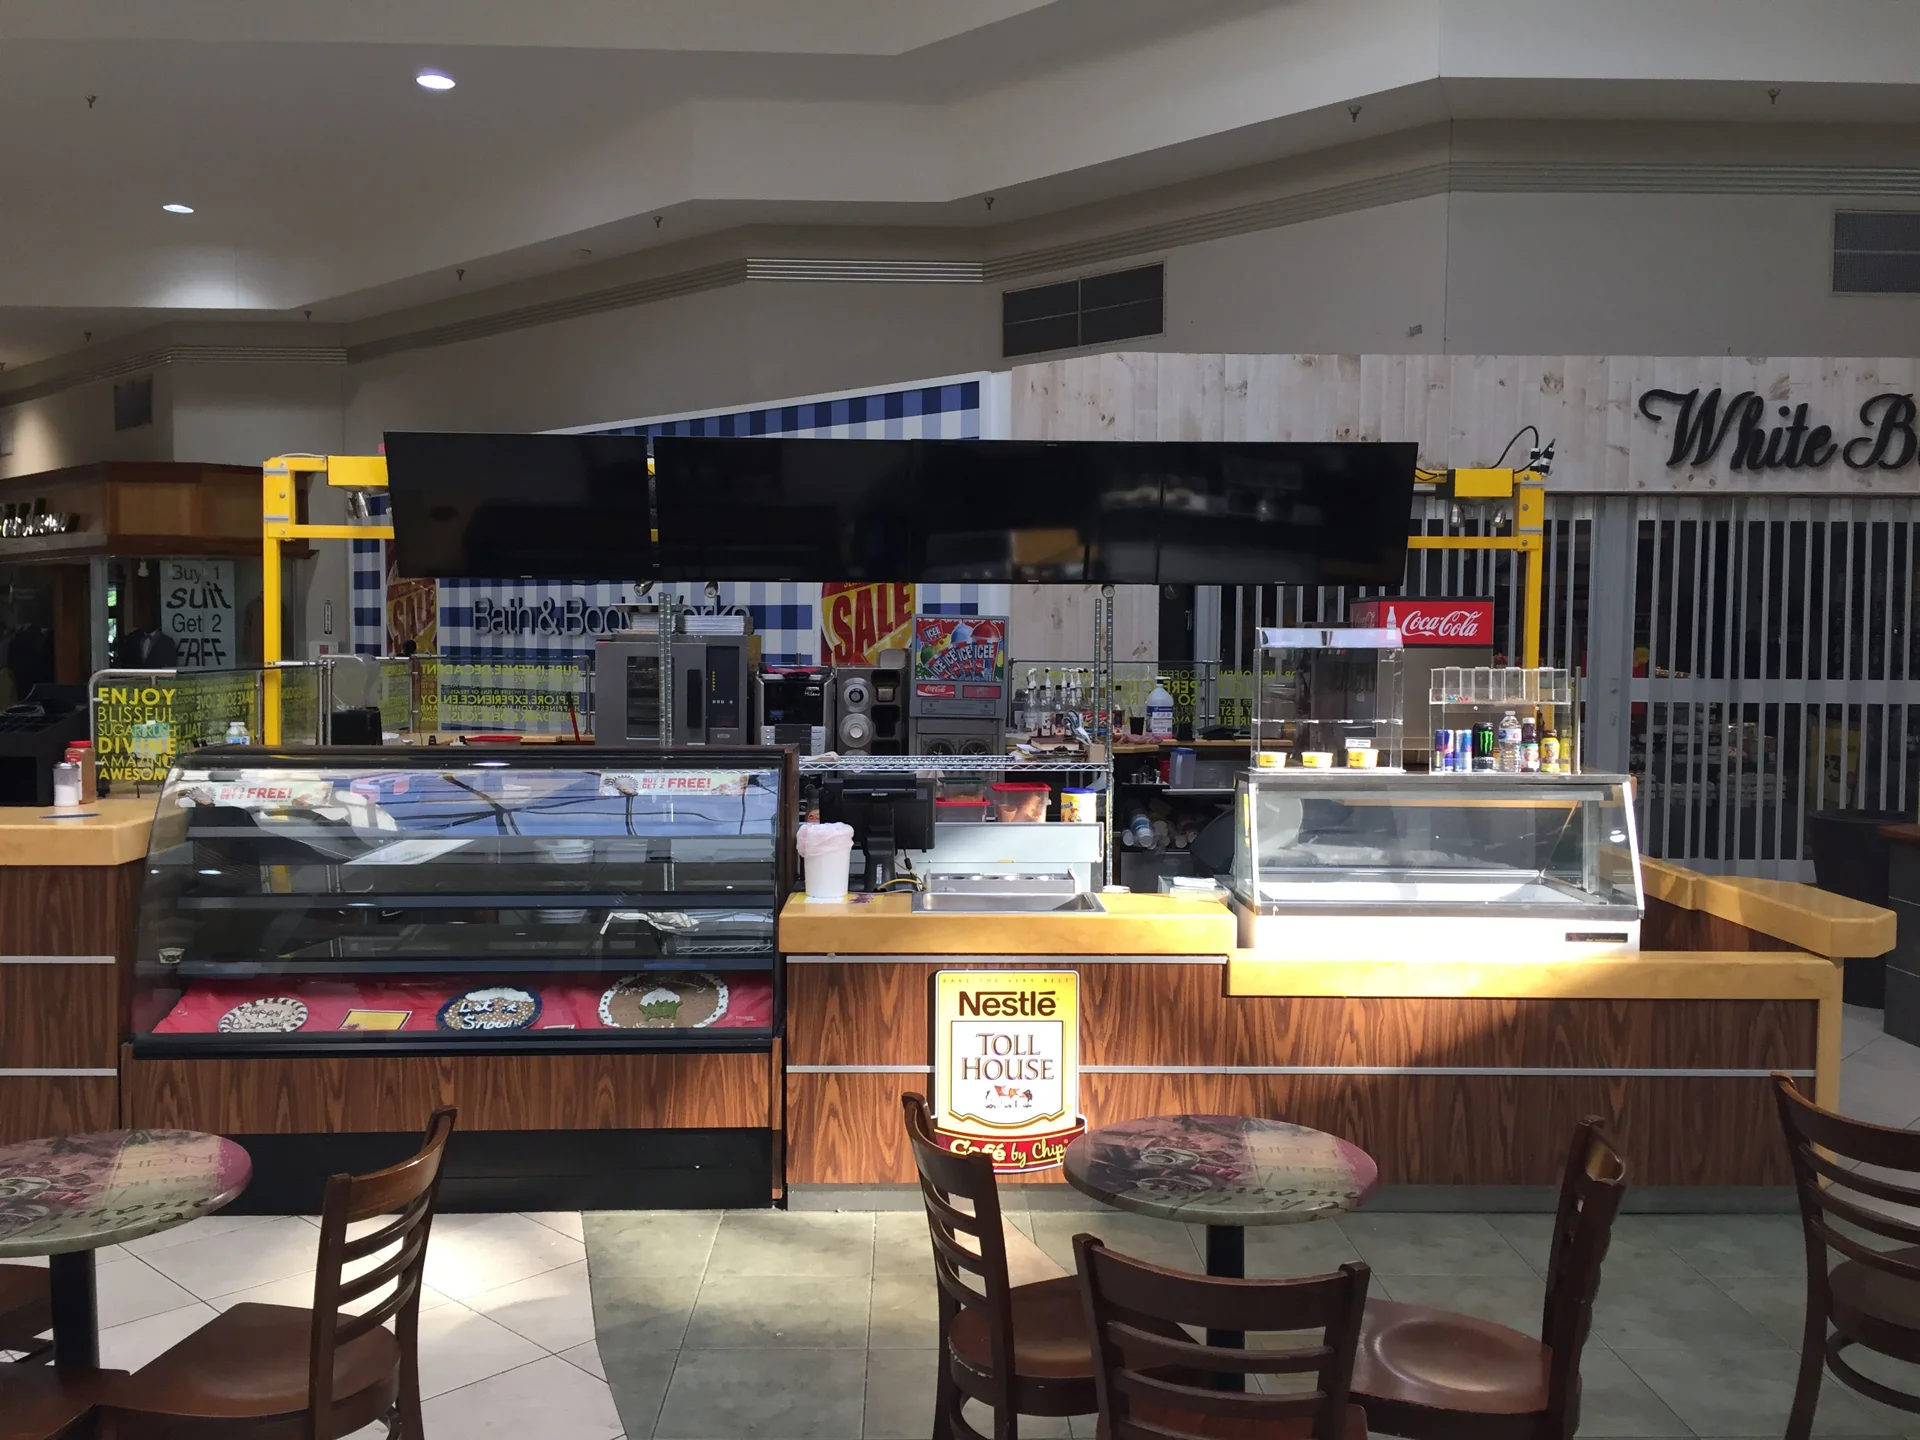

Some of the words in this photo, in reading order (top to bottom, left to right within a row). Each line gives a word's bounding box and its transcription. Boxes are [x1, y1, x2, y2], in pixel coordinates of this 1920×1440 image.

[1638, 388, 1838, 471] White
[1843, 392, 1920, 471] B
[213, 565, 220, 580] 1
[166, 581, 232, 609] suit
[171, 612, 203, 633] Get
[211, 613, 222, 633] 2
[473, 597, 536, 635] Bath
[832, 583, 913, 666] SALE
[1401, 610, 1484, 637] Coca-Cola
[925, 626, 941, 639] ICEE
[943, 648, 958, 666] ICE
[957, 645, 973, 661] ICE
[974, 644, 994, 659] ICEE
[931, 660, 946, 675] ICE
[98, 688, 176, 705] ENJOY
[98, 707, 176, 722] BLISSFUL
[98, 723, 141, 737] SUGAR
[98, 737, 177, 755] DIVINE
[100, 755, 176, 769] AMAZING
[99, 768, 168, 781] AWESOM
[667, 777, 711, 789] FREE!
[246, 787, 293, 799] FREE!
[959, 990, 1056, 1017] Nestlé
[975, 1032, 1042, 1056] TOLL
[961, 1057, 1055, 1081] HOUSE
[1010, 1142, 1027, 1168] by
